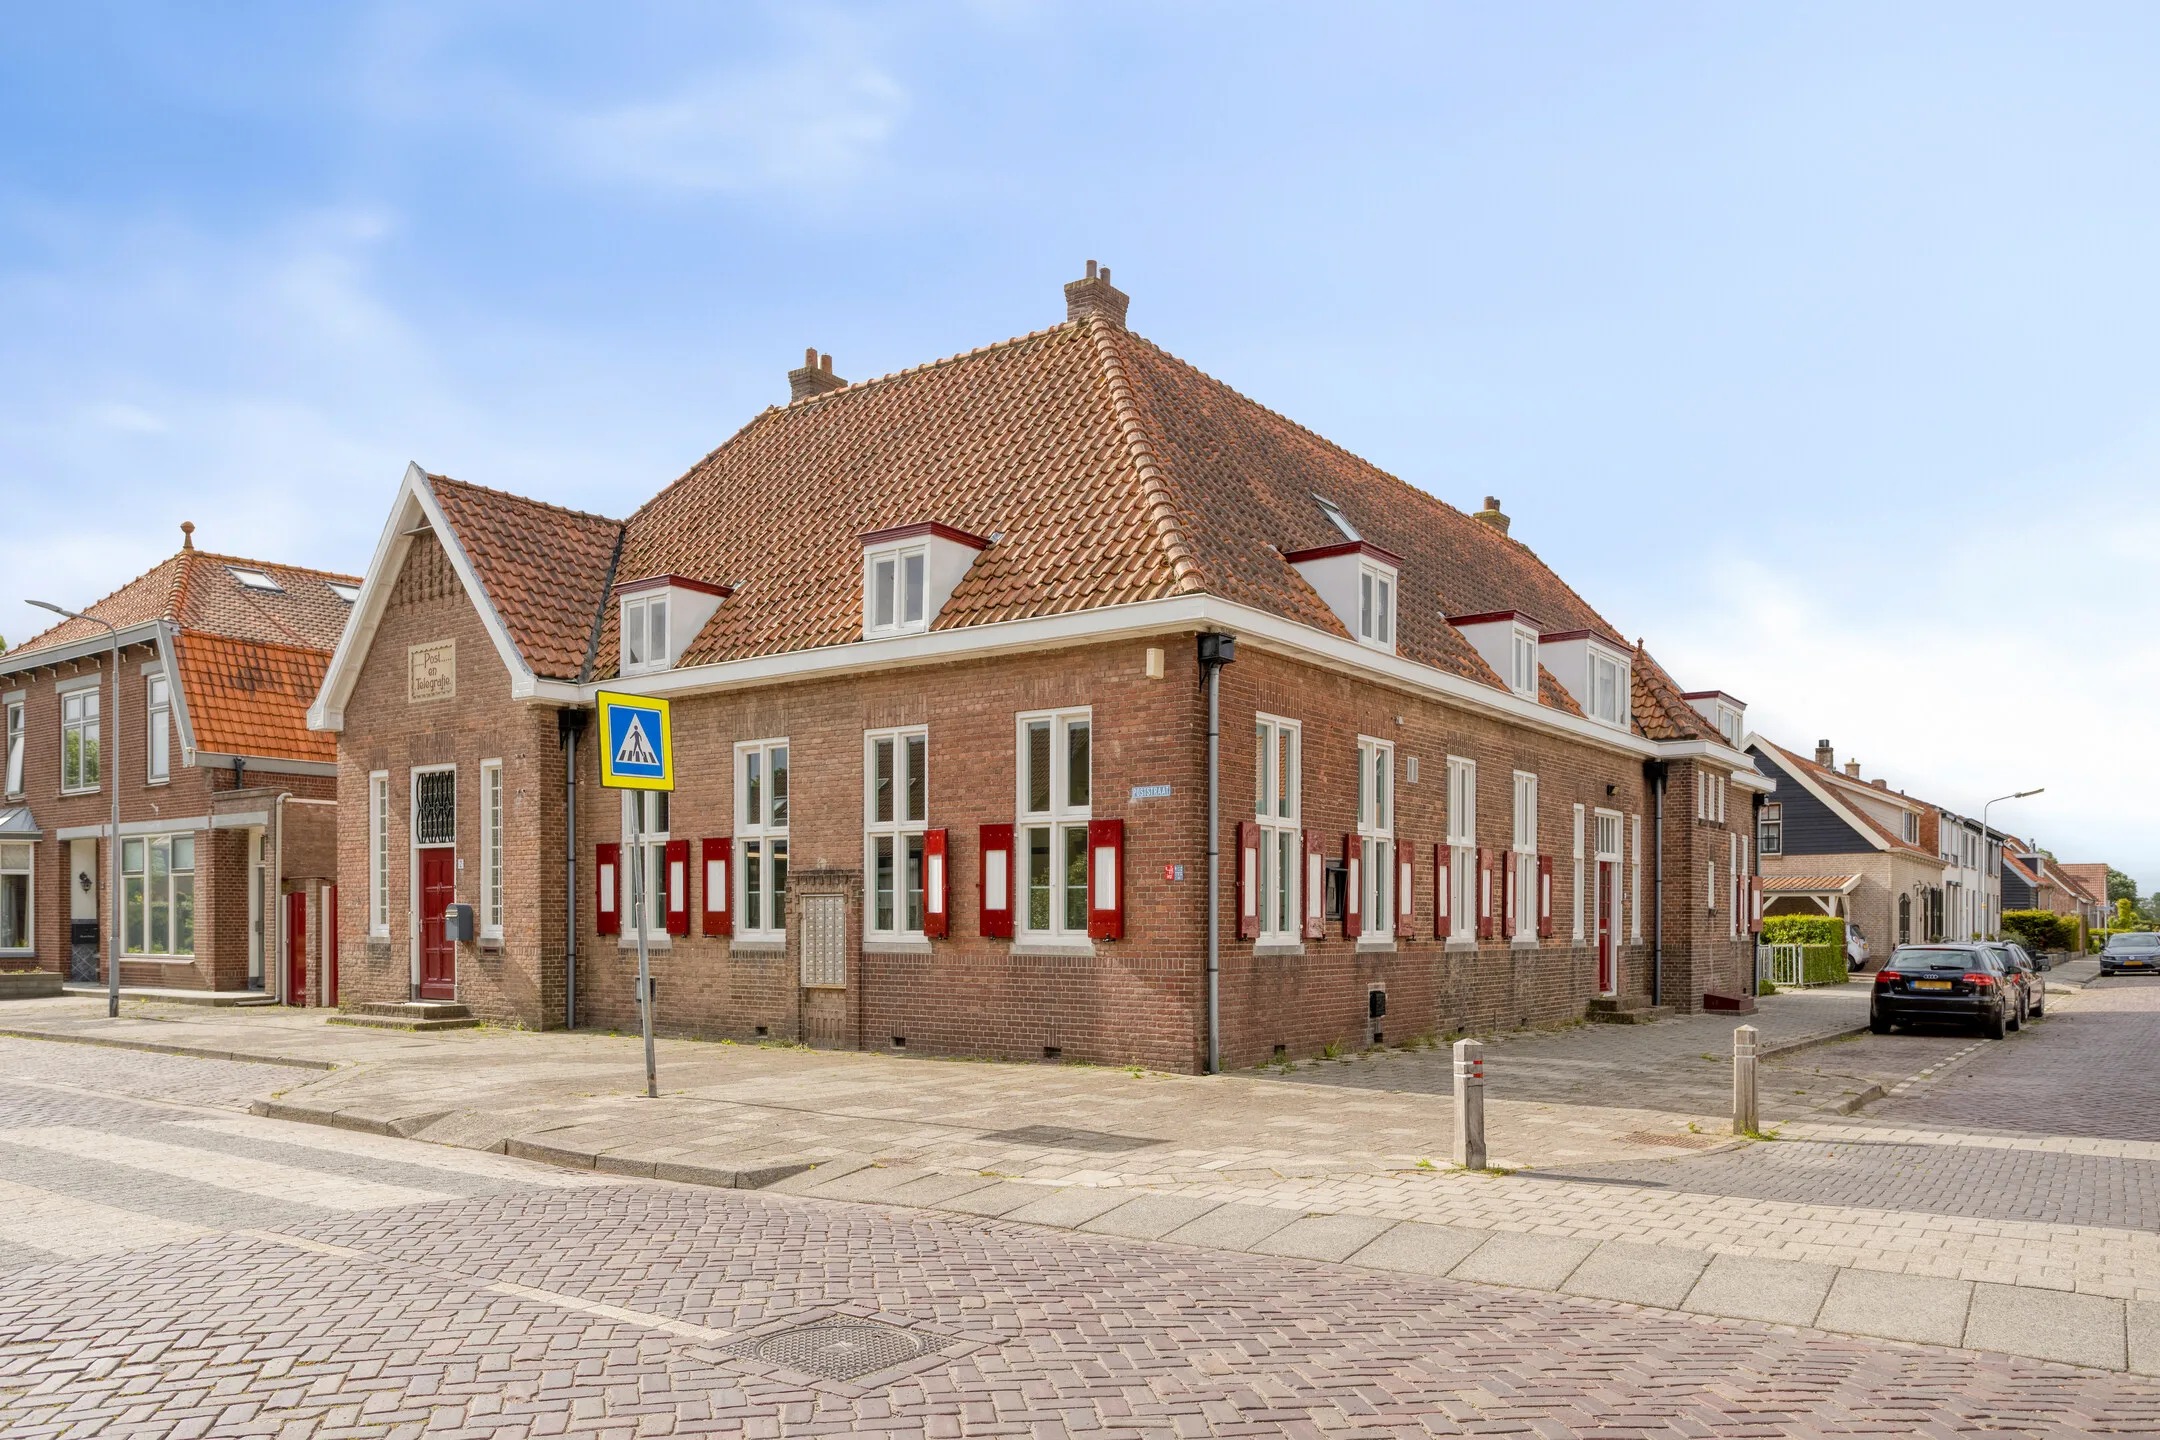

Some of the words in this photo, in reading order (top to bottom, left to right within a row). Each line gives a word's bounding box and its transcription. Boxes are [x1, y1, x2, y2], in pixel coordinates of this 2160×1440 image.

[424, 651, 441, 668] Post
[428, 667, 438, 676] en
[416, 674, 450, 691] Telegrafie
[1132, 786, 1170, 797] POSTSTRAAT
